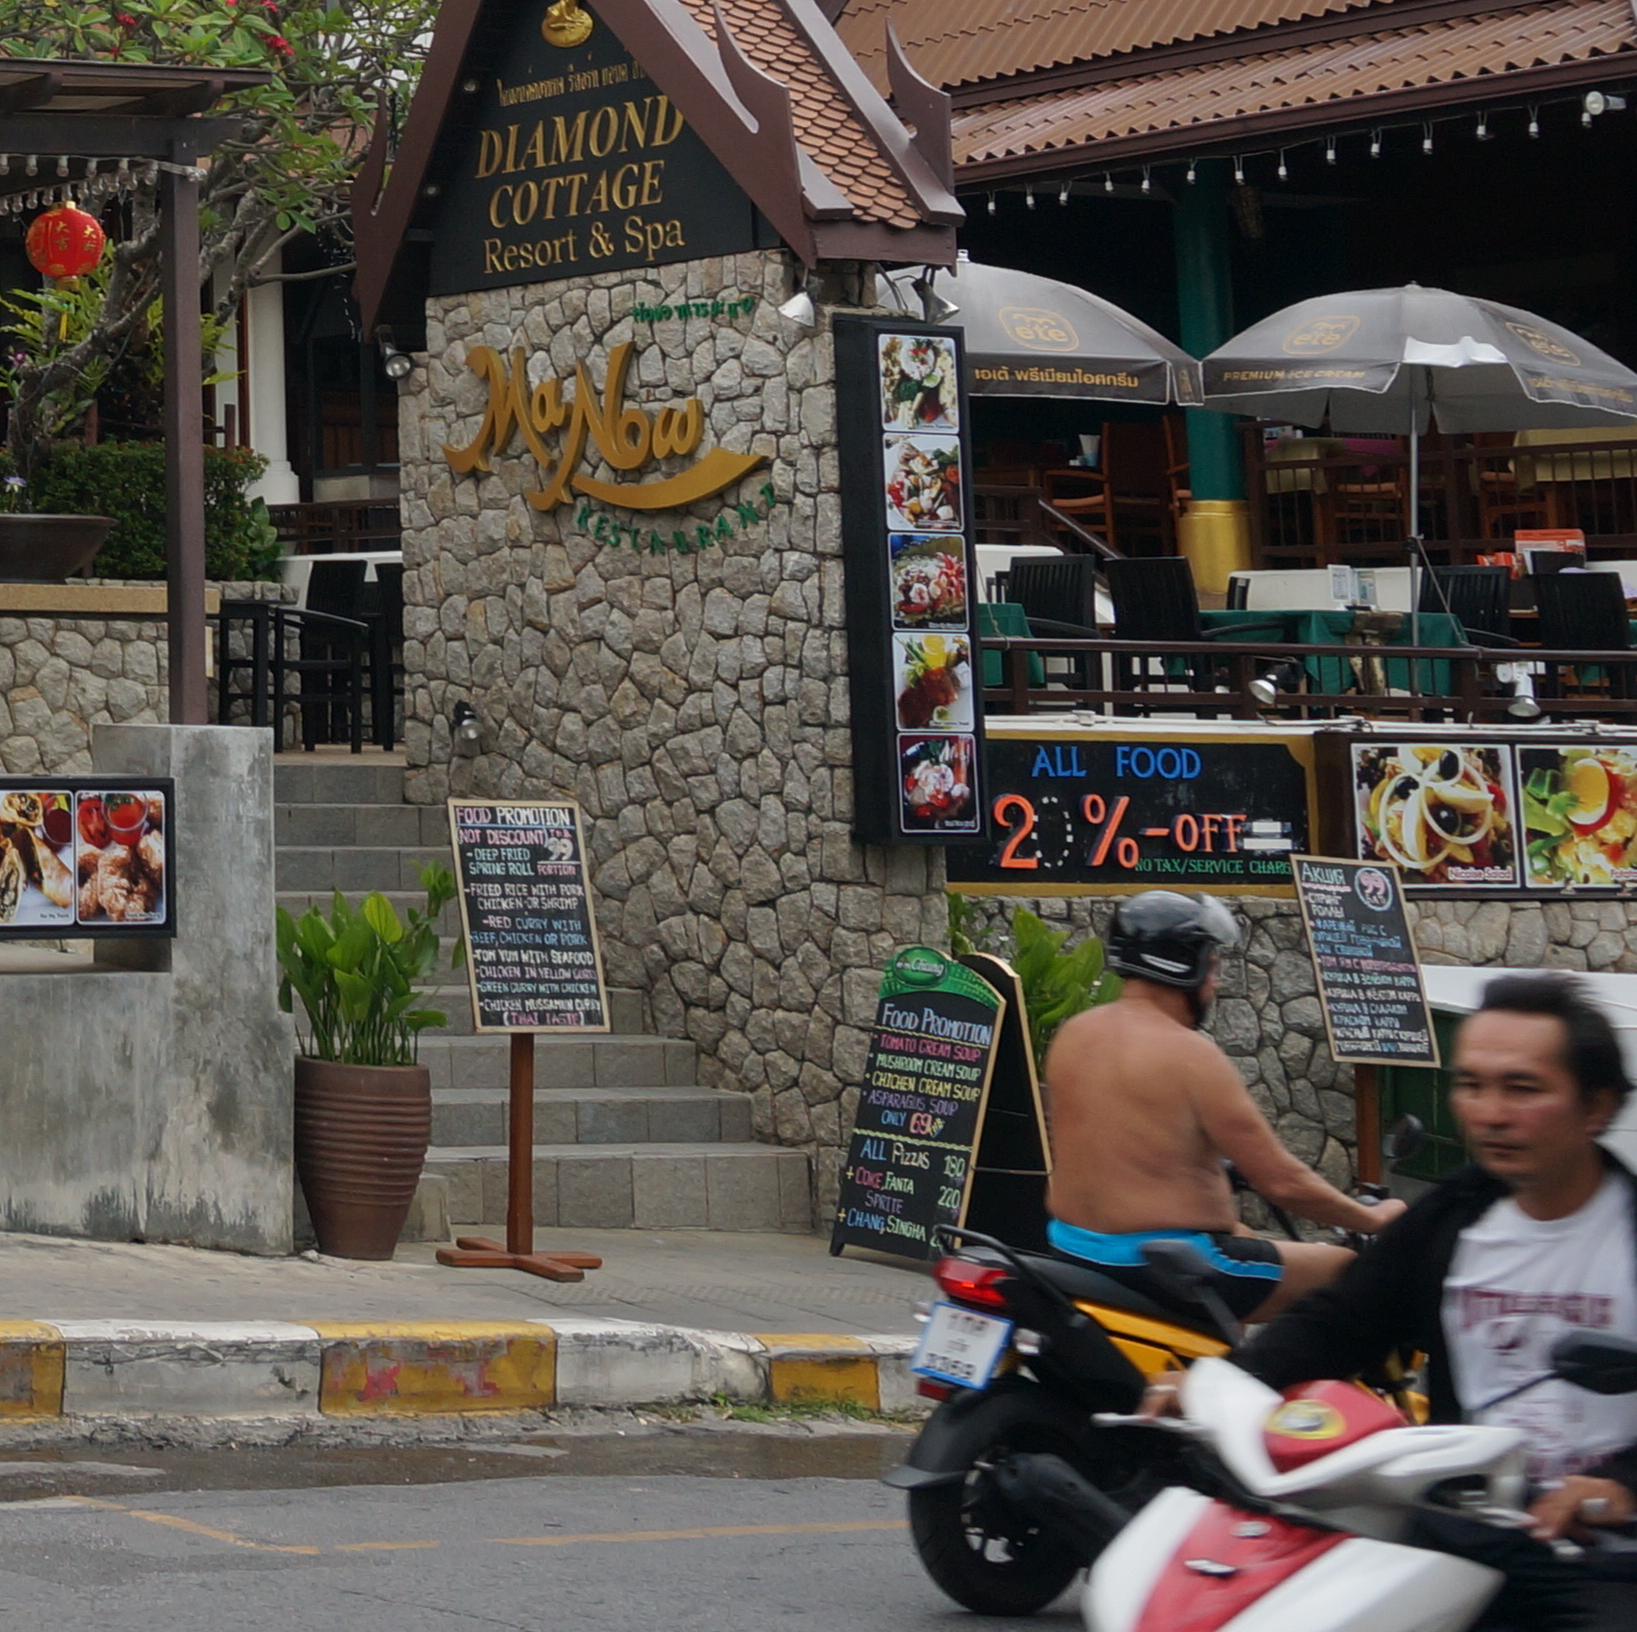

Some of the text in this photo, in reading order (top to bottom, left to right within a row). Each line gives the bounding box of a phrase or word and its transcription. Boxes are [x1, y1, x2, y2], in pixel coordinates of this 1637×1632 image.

[476, 95, 684, 179] DIAMOND
[488, 159, 666, 230] COTTAGE
[483, 215, 686, 274] Resort & Spa
[1223, 369, 1367, 382] PREMIUM ICE CREAM
[576, 481, 776, 555] RESTAURANT
[1031, 744, 1203, 780] ALL FOOD
[456, 807, 572, 826] FOOD PROMOTION
[500, 847, 531, 861] FRIED
[546, 836, 574, 861] 99
[468, 862, 506, 876] SPRING
[508, 862, 535, 877] ROLL
[1135, 858, 1152, 873] NO
[1152, 858, 1244, 875] TAX/SERVICE
[504, 883, 529, 897] RICE
[530, 884, 557, 896] WITH
[1358, 871, 1386, 896] 99
[477, 897, 524, 910] CHICKEN
[541, 897, 579, 910] SHRIMP
[515, 917, 548, 931] CURRY
[551, 919, 582, 931] WITH
[499, 931, 543, 945] CHICKEN
[543, 932, 559, 946] OR
[560, 932, 588, 946] PORK
[497, 949, 519, 963] YUM
[520, 949, 549, 964] WITH
[550, 949, 594, 965] SEAFOOD
[524, 966, 538, 979] IN
[538, 967, 572, 980] YELLOW
[538, 983, 561, 995] WITH
[561, 982, 598, 995] CHICKEN
[882, 1003, 993, 1046] FOOD PROMOTION
[880, 1034, 981, 1062] TOMATO CREAM SOUP
[875, 1053, 982, 1081] MUSHROOM CREAM SOUP
[918, 1077, 952, 1098] CREAM
[952, 1083, 982, 1102] SOUP
[867, 1090, 960, 1117] ASPARAGUS SOUP
[881, 1109, 908, 1128] ONLY
[909, 1112, 932, 1136] 69
[859, 1138, 887, 1162] ALL
[943, 1155, 966, 1178] 180
[864, 1190, 905, 1215] SPRITE
[937, 1185, 962, 1210] 220
